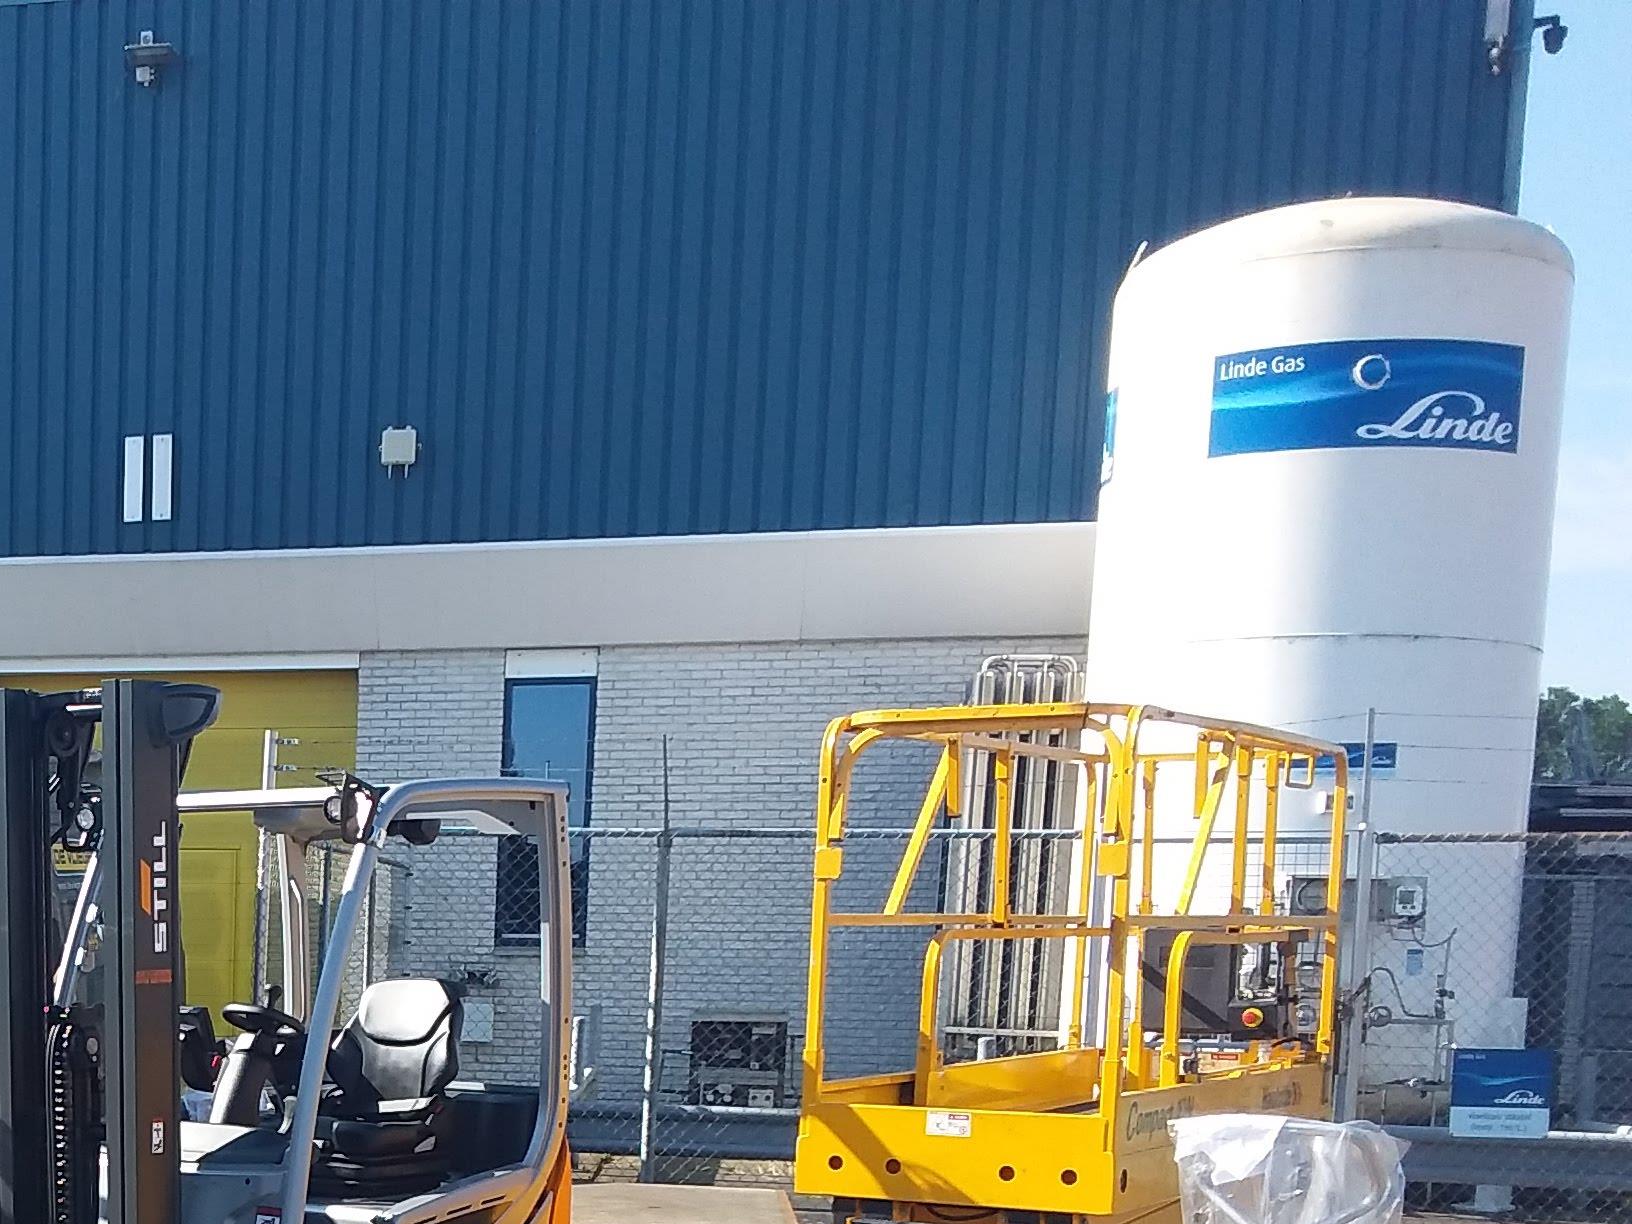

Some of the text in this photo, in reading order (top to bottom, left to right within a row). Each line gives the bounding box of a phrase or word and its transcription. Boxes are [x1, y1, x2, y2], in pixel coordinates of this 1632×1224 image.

[1220, 353, 1305, 381] Linde Gas
[1356, 390, 1514, 445] Linde
[123, 434, 173, 523] 11
[153, 820, 167, 953] STILL
[1493, 1089, 1545, 1105] Linde
